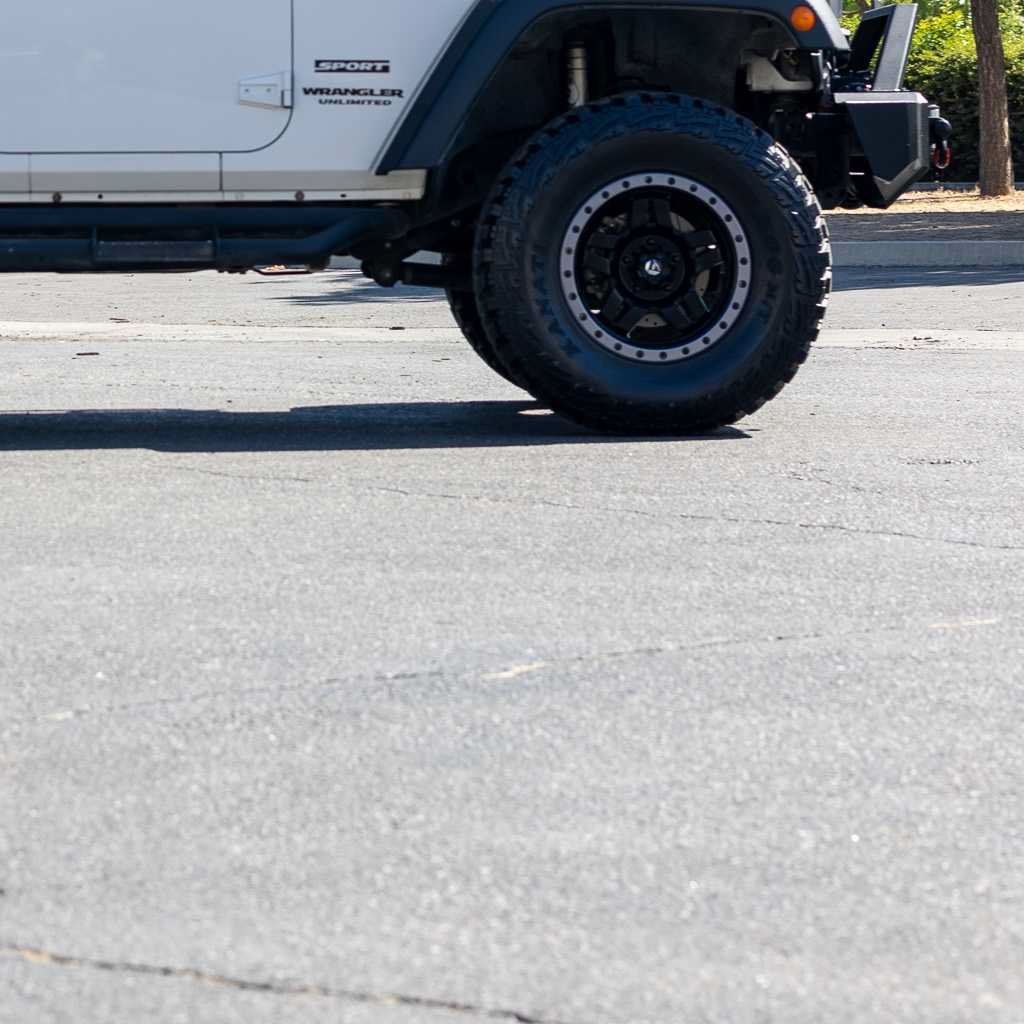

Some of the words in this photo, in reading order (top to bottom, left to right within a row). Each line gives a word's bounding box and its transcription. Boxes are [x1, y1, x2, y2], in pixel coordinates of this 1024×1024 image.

[317, 61, 388, 73] SPORT
[302, 87, 404, 98] WRANGLER
[318, 98, 392, 106] UNLIMITED
